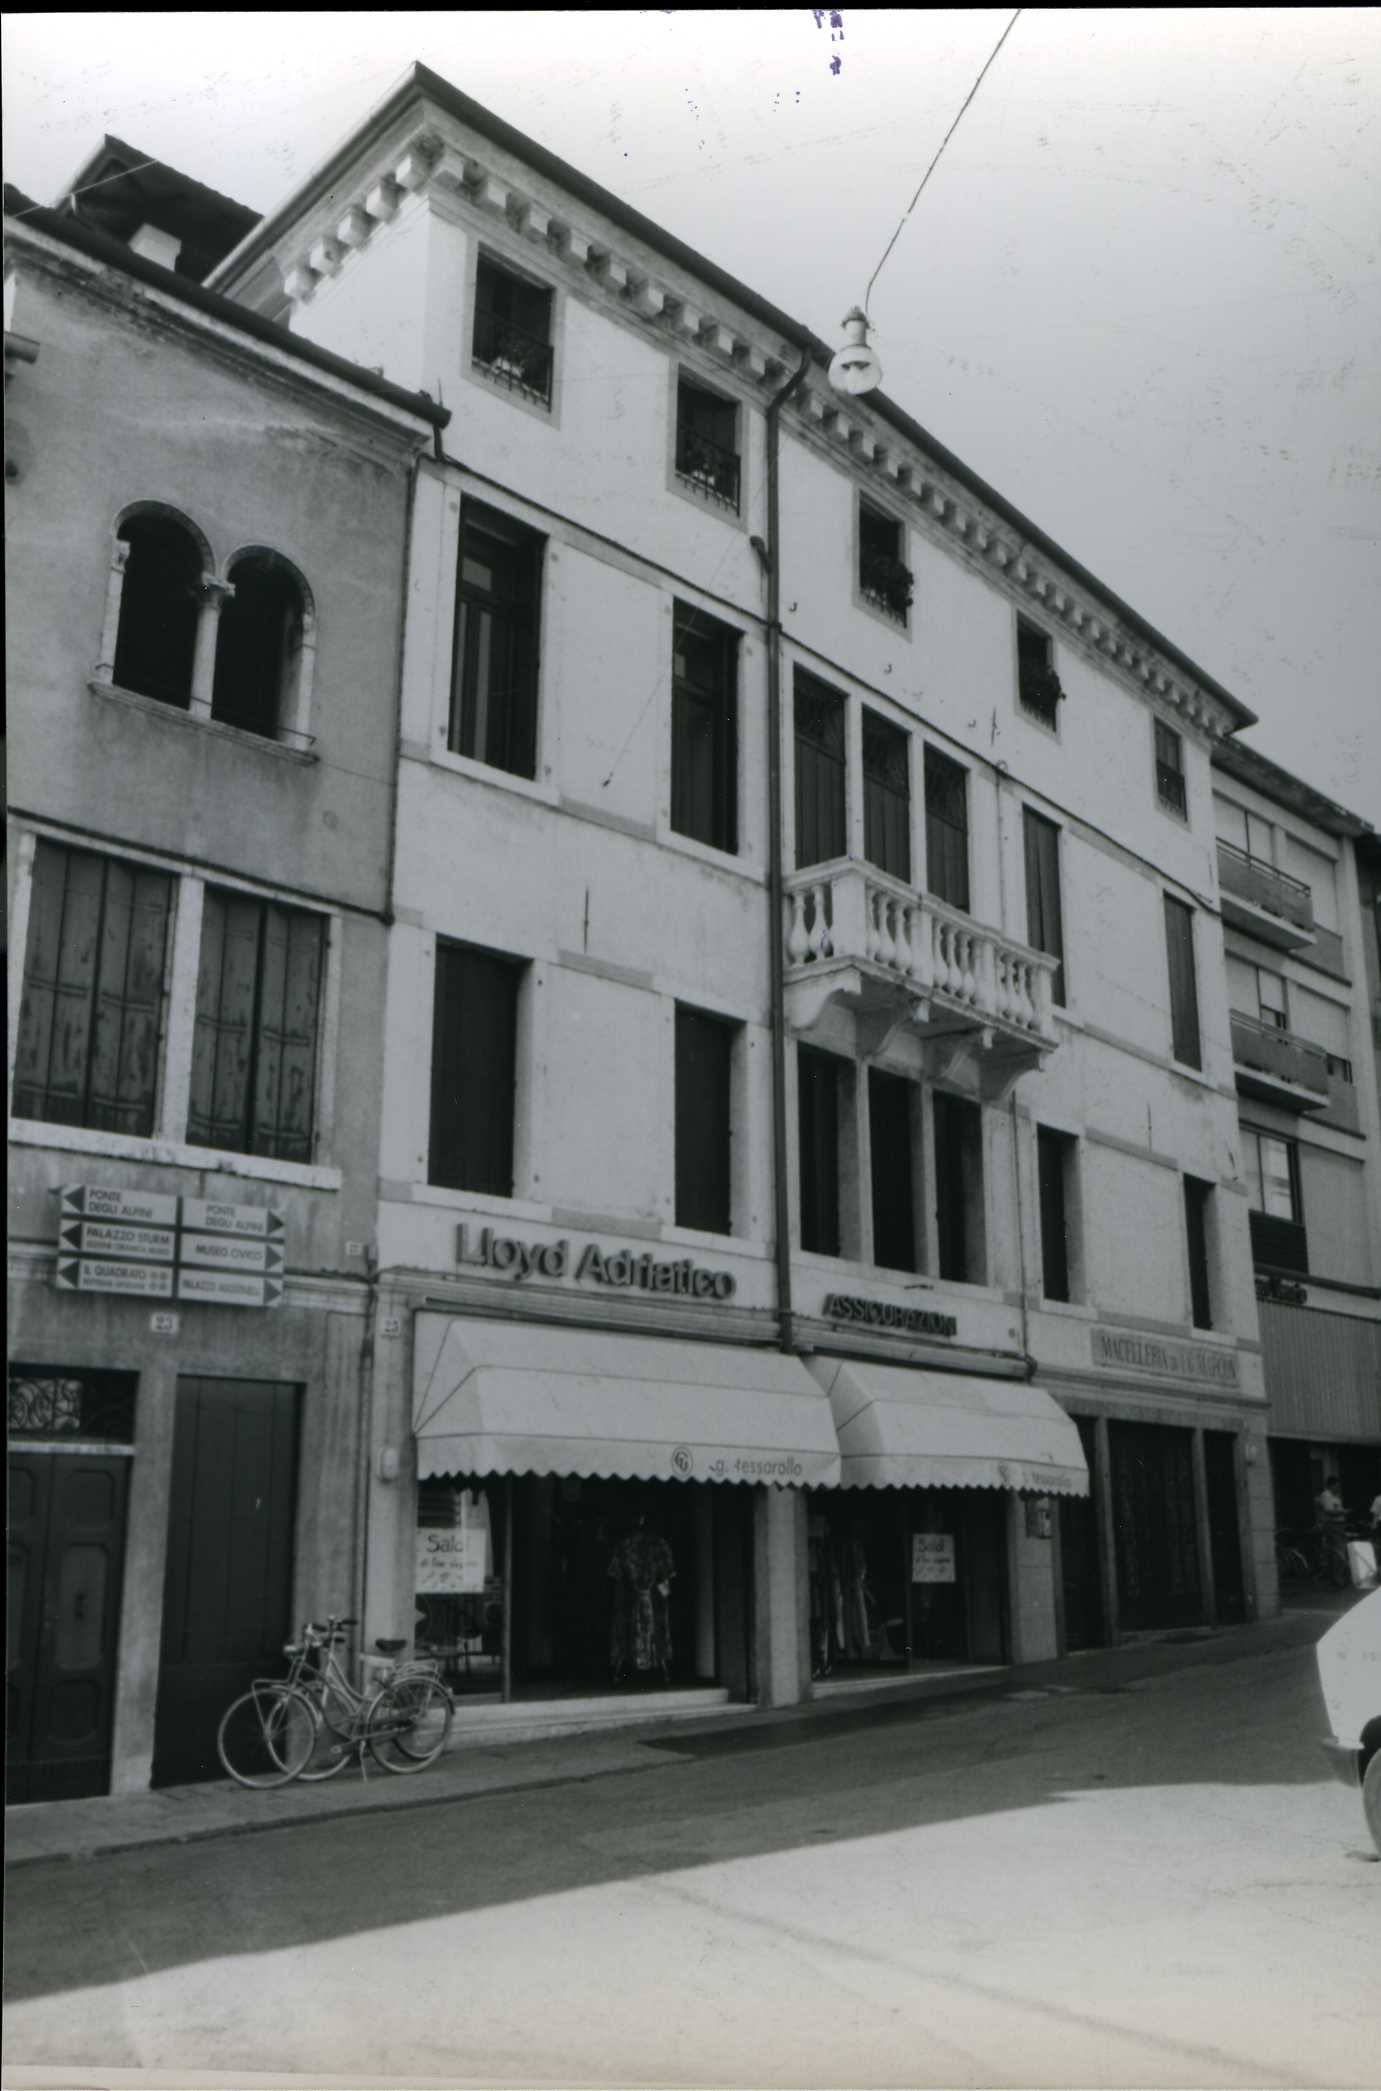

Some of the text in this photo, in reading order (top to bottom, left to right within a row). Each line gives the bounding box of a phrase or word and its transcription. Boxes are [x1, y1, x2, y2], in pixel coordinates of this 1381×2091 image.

[89, 1190, 122, 1203] PONTE
[88, 1202, 153, 1218] DEGLI ALPINI
[86, 1227, 169, 1244] PALAZZO STURM
[196, 1244, 228, 1257] MUSEO
[455, 1223, 737, 1300] Lloyd Adriatico
[94, 1265, 146, 1280] QUADRATO
